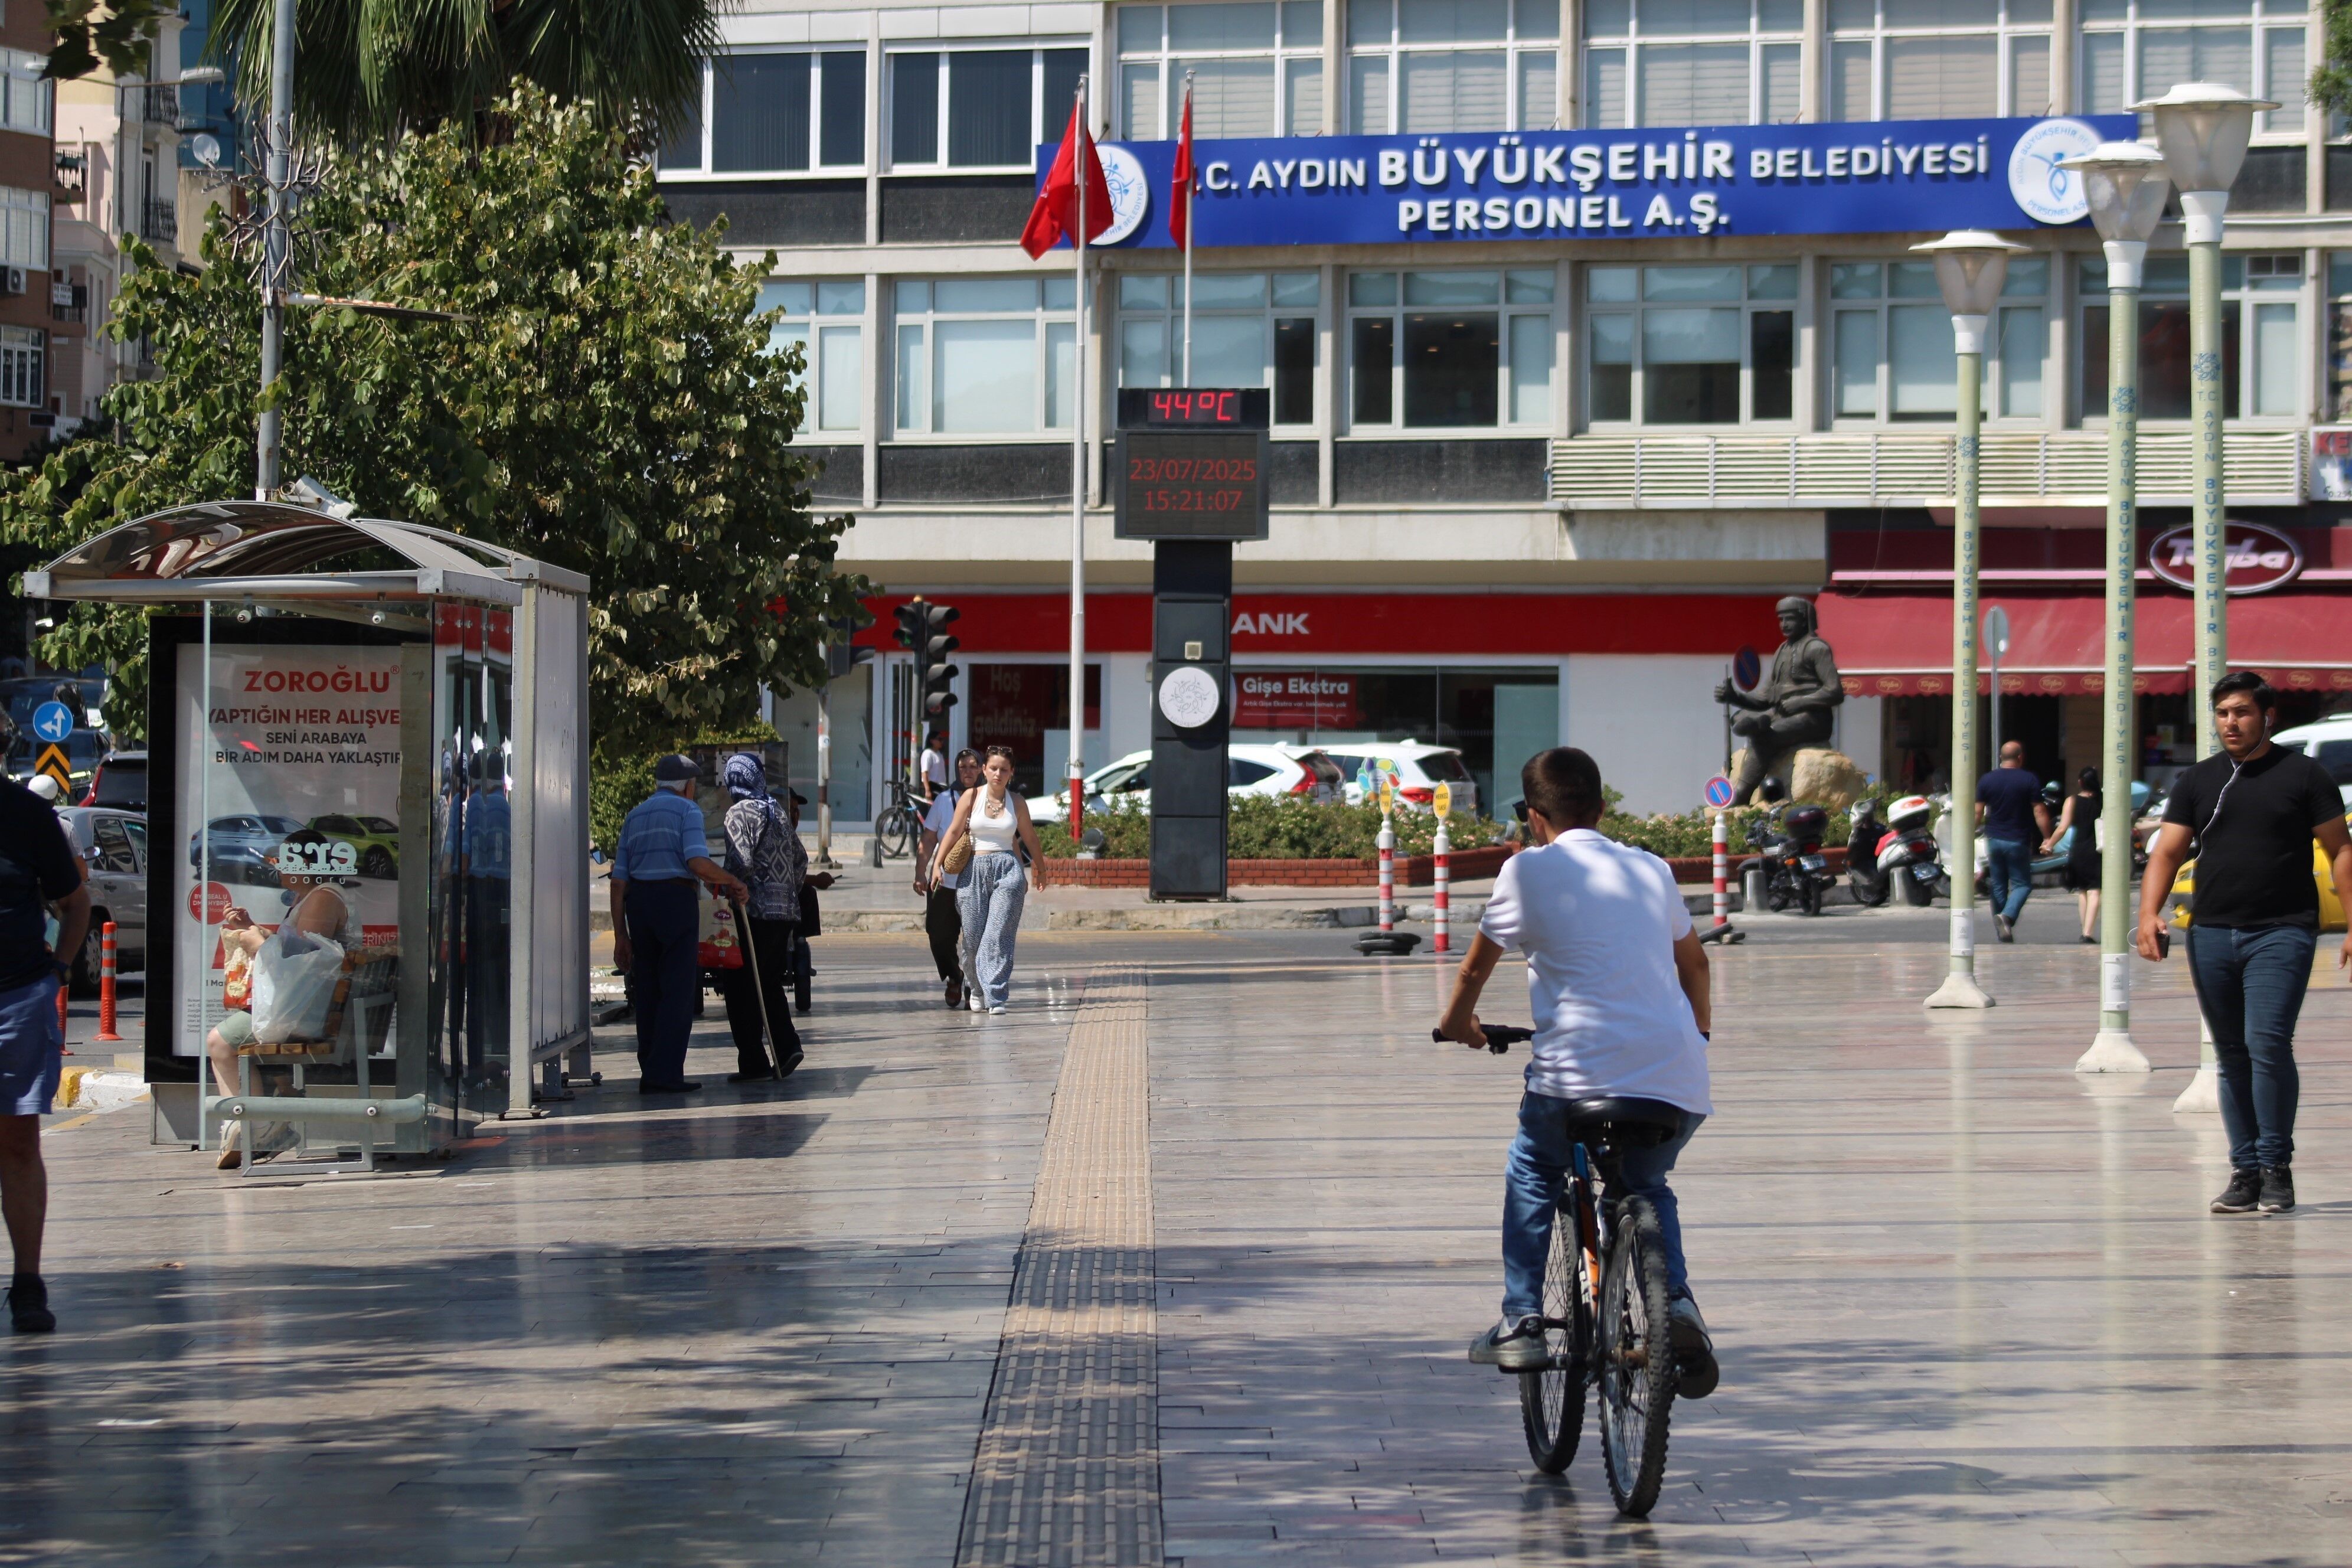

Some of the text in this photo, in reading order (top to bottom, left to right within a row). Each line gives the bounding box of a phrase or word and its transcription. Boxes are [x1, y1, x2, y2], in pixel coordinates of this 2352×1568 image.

[1196, 132, 1990, 192] .C. AYDIN BÜYÜKŞEHİR BELEDİYESİ
[1399, 193, 1730, 234] PERSONEL A.Ş.
[1129, 459, 1257, 484] 23/07/2025
[1144, 489, 1243, 511] 15:21:07
[1231, 613, 1311, 635] ANK
[1242, 677, 1349, 698] Gişe Ekstra
[296, 709, 331, 724] HER
[336, 708, 400, 729] ALIŞVE
[266, 729, 367, 744] SENİ ARABAYA
[215, 748, 239, 763] BİR
[241, 751, 279, 763] ADIM
[283, 751, 324, 764] DAHA
